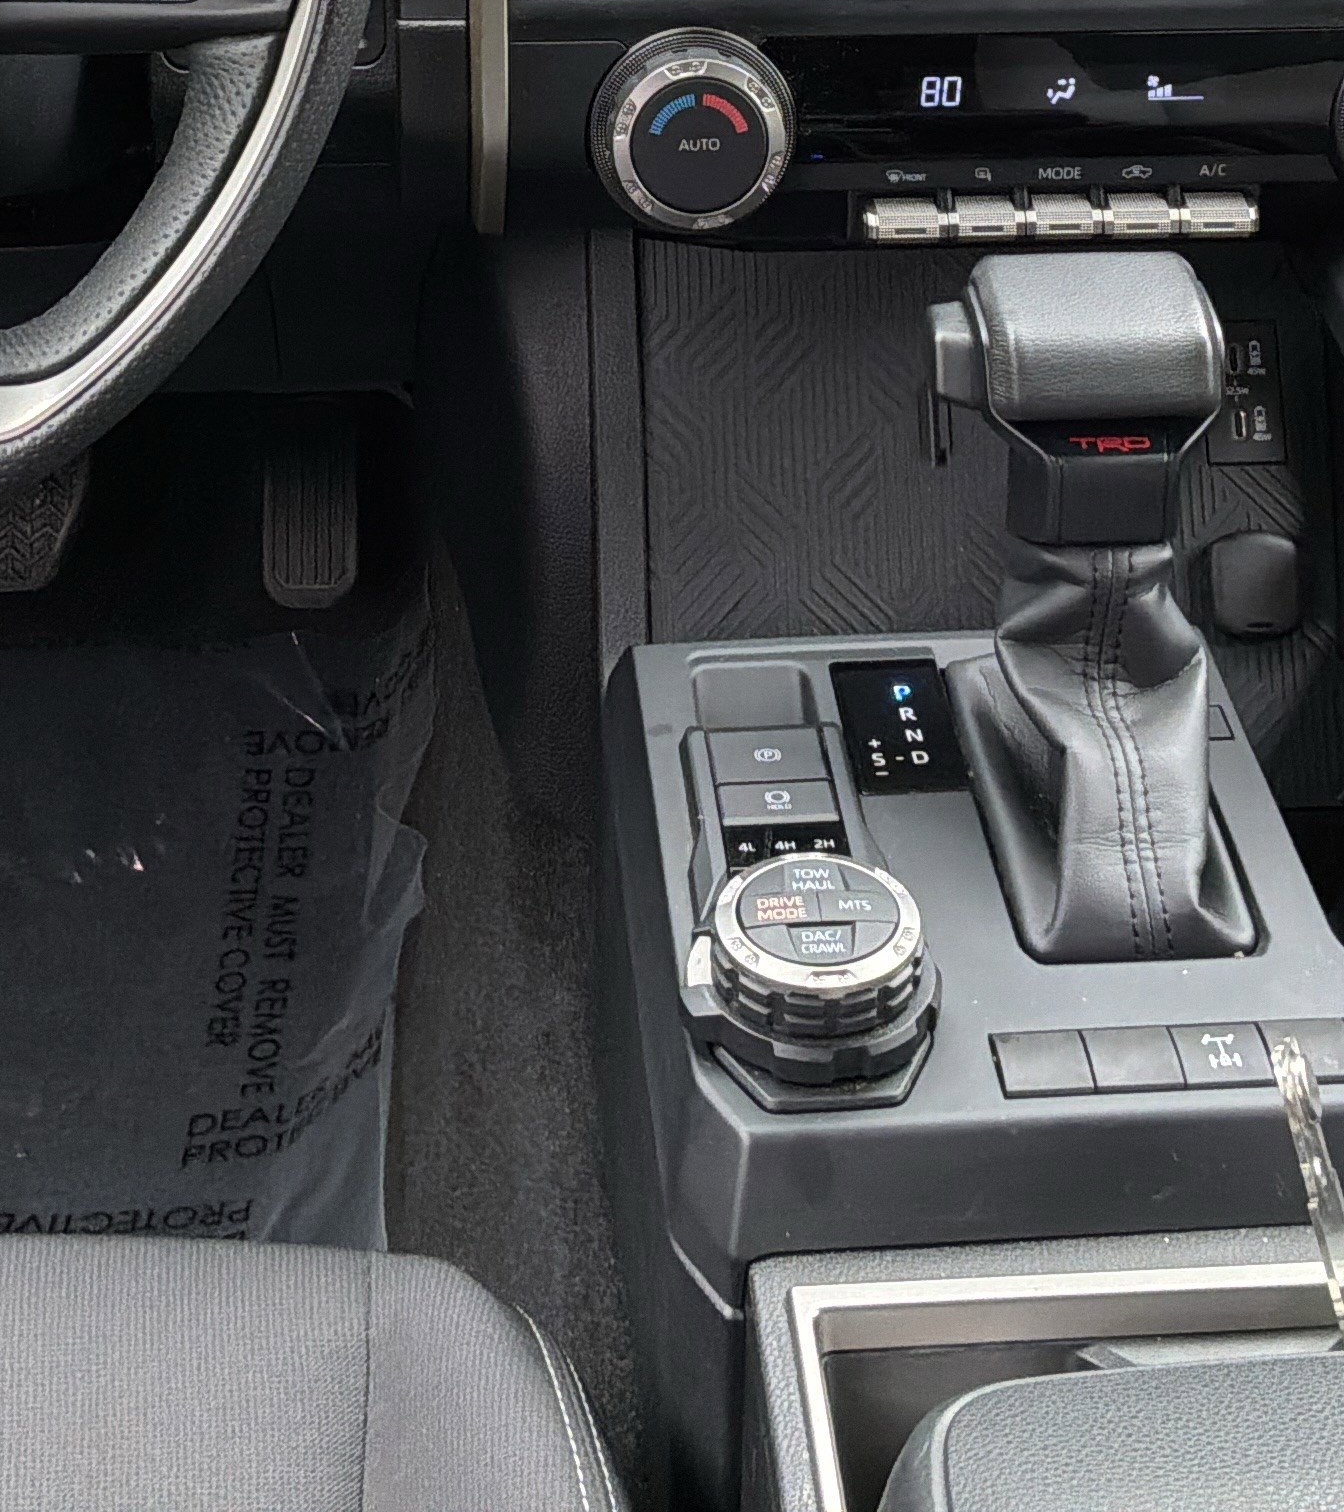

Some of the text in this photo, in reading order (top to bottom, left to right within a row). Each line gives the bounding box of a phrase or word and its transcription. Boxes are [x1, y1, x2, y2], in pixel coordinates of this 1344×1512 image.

[920, 76, 962, 108] 80
[678, 138, 721, 152] AUTO
[903, 173, 926, 182] FRONT
[1038, 167, 1082, 180] MODE
[1199, 164, 1227, 177] A/C
[1068, 436, 1151, 453] TRD
[893, 685, 912, 702] P
[899, 707, 917, 721] R
[905, 728, 924, 742] N
[872, 752, 886, 766] S
[911, 750, 930, 765] D
[739, 839, 835, 853] 4L 4H 2H
[793, 869, 829, 879] TOW
[792, 879, 835, 891] HAUL
[206, 768, 273, 1049] PROTECTIVE COVER
[756, 895, 805, 909] DRIVE
[838, 899, 872, 911] MTS
[757, 908, 808, 921] MODE
[240, 766, 316, 1099] DEALER MUST REMOVE
[801, 929, 841, 942] DAC/
[801, 941, 846, 954] CRAWL
